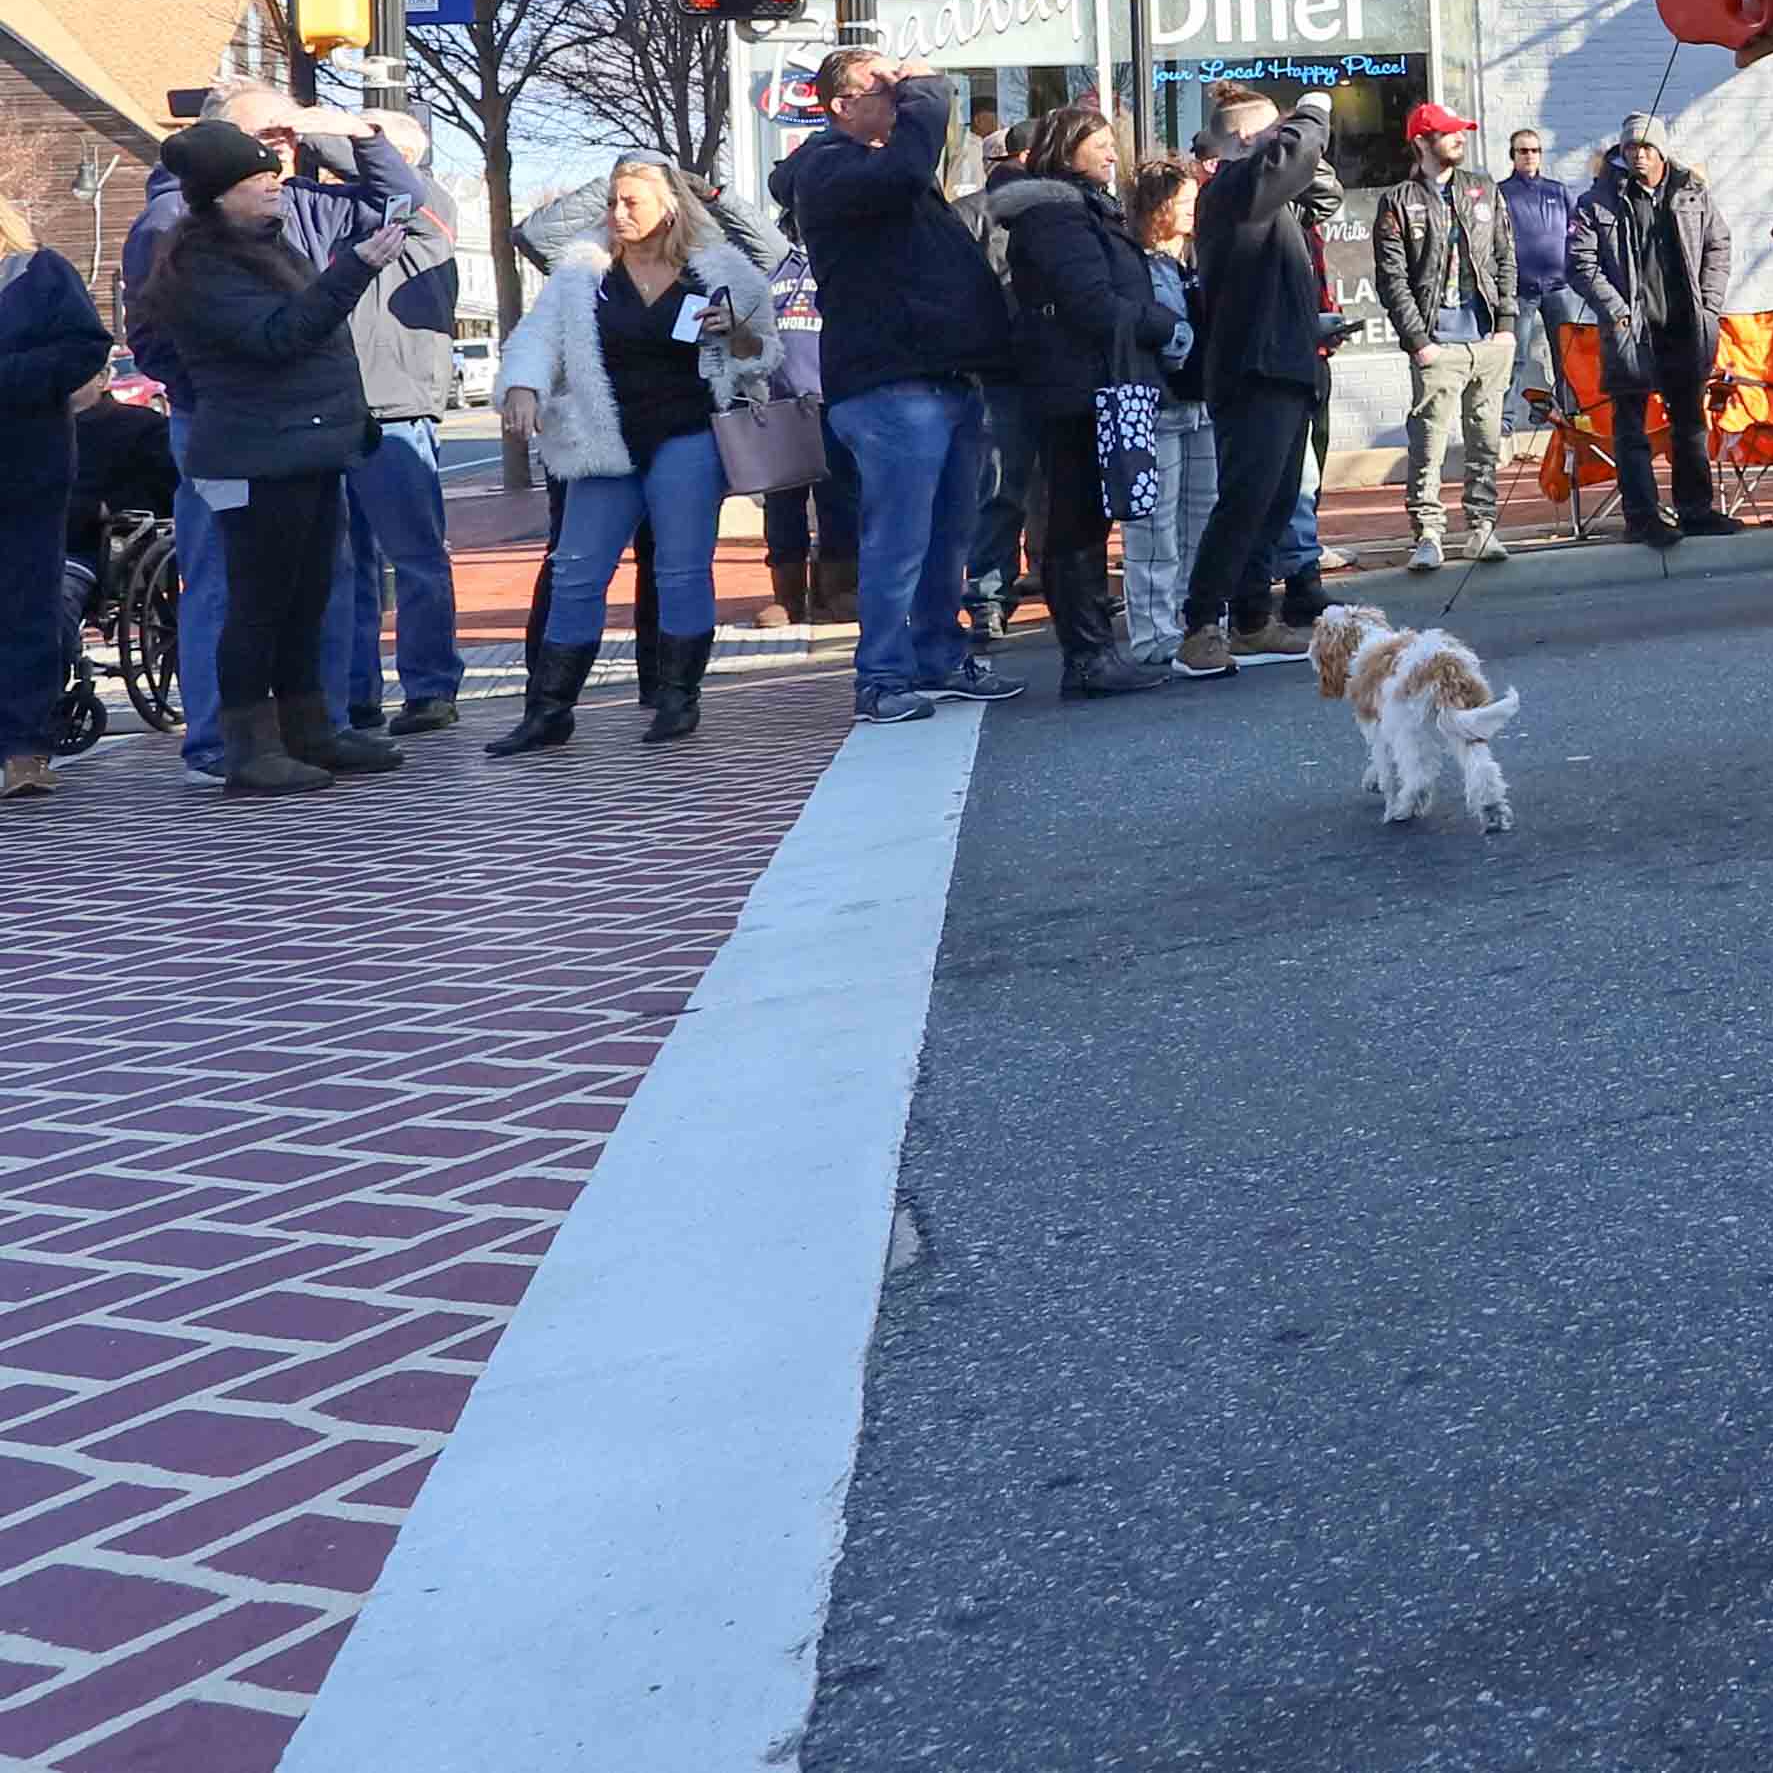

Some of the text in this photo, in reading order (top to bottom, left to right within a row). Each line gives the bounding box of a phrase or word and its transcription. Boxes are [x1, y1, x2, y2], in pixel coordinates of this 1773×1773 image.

[1200, 58, 1265, 84] Local
[1268, 57, 1339, 87] Happy
[1341, 54, 1408, 78] Place!
[776, 315, 823, 332] WORLD
